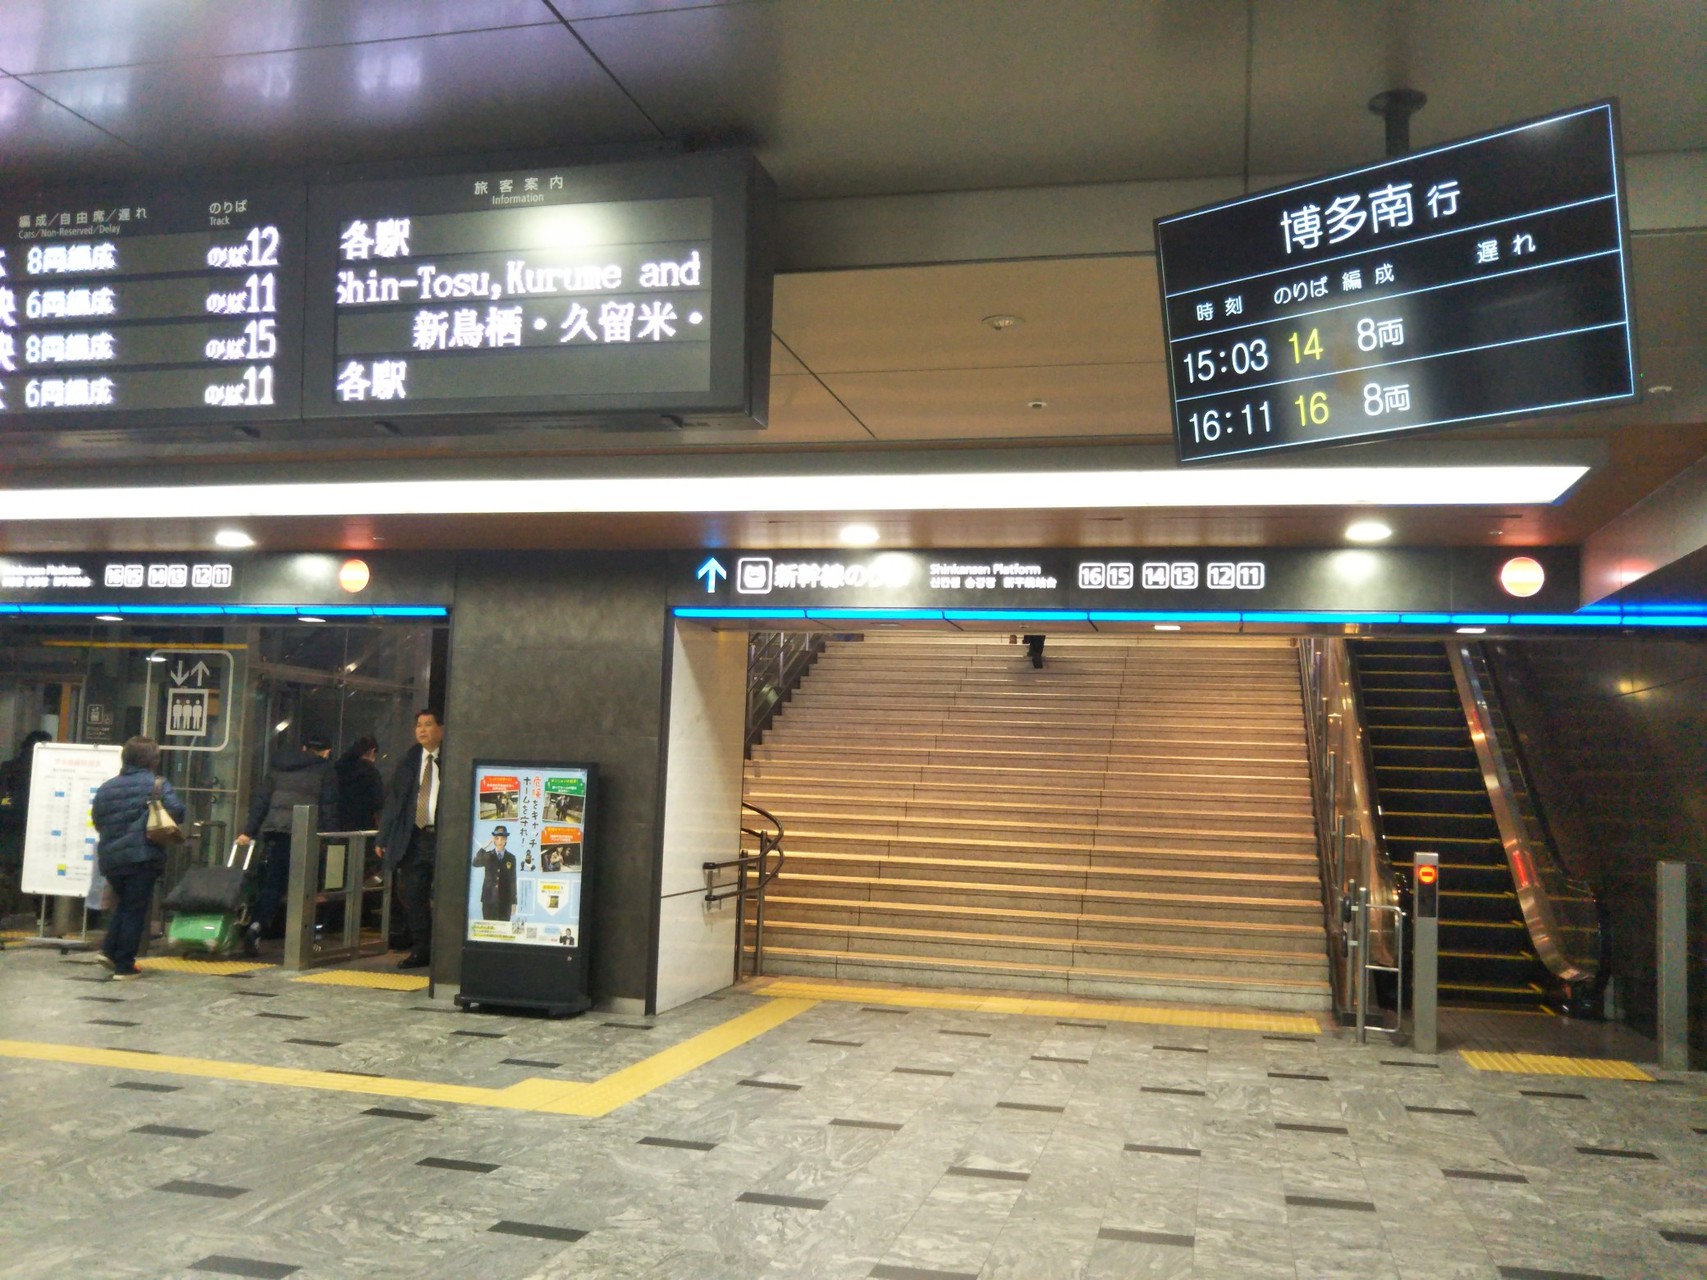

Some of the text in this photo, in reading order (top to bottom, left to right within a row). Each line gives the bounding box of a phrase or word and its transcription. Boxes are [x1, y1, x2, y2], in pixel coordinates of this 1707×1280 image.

[474, 175, 563, 195] 旅客案内
[492, 193, 544, 205] Information
[209, 199, 247, 214] のりば
[209, 215, 230, 226] Track
[1280, 180, 1461, 254] 博多南行
[341, 219, 411, 261] 各駅
[1476, 234, 1536, 264] 遅れ
[640, 251, 701, 288] and
[1342, 264, 1395, 291] 編成
[1273, 276, 1329, 305] のりば
[1196, 296, 1242, 322] 時刻
[1356, 317, 1406, 352] 8両
[1183, 328, 1325, 383] 15:03 14
[336, 361, 407, 401] 各駅
[1362, 383, 1411, 417] 8両
[1188, 391, 1330, 443] 16:11 16
[930, 562, 1041, 575] Shinkansen Platform
[1082, 567, 1260, 585] 16 15 14 13 12 11
